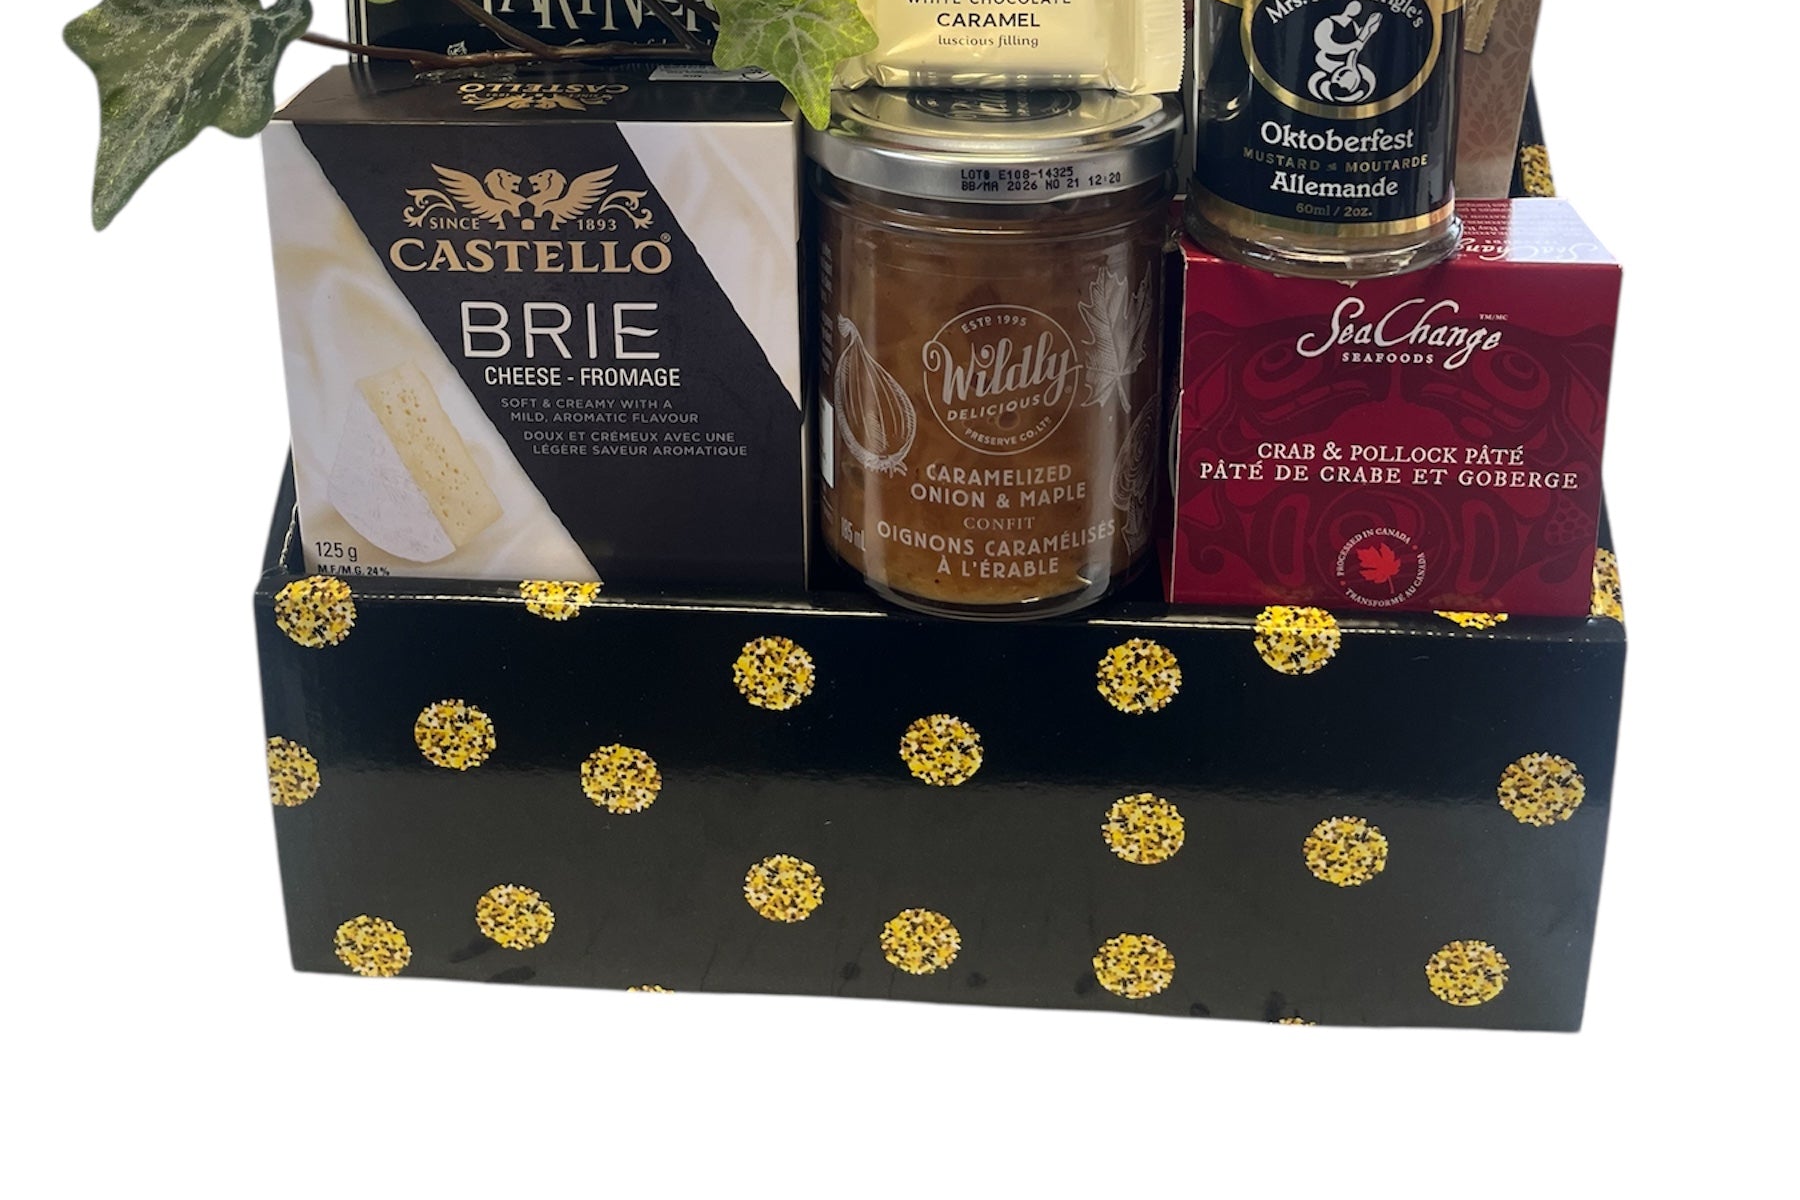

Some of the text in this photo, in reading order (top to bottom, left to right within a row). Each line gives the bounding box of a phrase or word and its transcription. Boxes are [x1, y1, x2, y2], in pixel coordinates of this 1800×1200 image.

[937, 13, 1040, 27] CARAMEL
[938, 35, 1039, 48] luscious filling
[458, 83, 629, 94] CASTELLO
[1261, 121, 1414, 152] Oktoberfest
[1243, 146, 1428, 173] MUSTARD MOUTARDE
[961, 172, 1121, 191] BB/MA 2026 NO 21 12:20
[999, 166, 1074, 180] E108-14325
[1270, 171, 1399, 197] Allemande
[1296, 203, 1331, 215] 60ml
[1344, 206, 1373, 217] 2oz.
[430, 216, 617, 231] SINCE 1893
[389, 237, 672, 274] CASTELLO
[460, 301, 660, 359] BRIE
[997, 315, 1027, 327] 1995
[1342, 352, 1434, 364] SEAFOODS
[484, 366, 561, 386] CHEESE
[581, 367, 680, 386] FROMAGE
[922, 331, 1083, 406] Wildly
[500, 398, 672, 409] SOFT & CREAMY WITH A
[947, 394, 1041, 421] DELICIOUS
[510, 412, 699, 424] MILD, AROMATIC FLAVOUR
[523, 429, 735, 442] DOUX ET CRÉMEUX AVEC UNE
[965, 428, 1017, 446] PRESERVE
[533, 442, 748, 456] LÉGÈRE SAVEUR AROMATIQUE
[1257, 441, 1524, 465] CRAB & POLLOCK PÂTÉ
[926, 464, 1071, 487] CARAMELIZED
[1200, 459, 1578, 489] PÂTÉ DE CRABE ET GOBERGE
[910, 482, 1086, 508] ONION & MAPLE
[963, 516, 1036, 530] CONFIT
[877, 519, 1115, 557] OIGNONS CARAMÉLISÉS
[315, 542, 357, 562] 125 g
[1336, 527, 1411, 577] PROCESSED IN CANADA
[937, 555, 1059, 578] À L'ÉRABLE
[1405, 585, 1416, 598] AU
[1413, 552, 1427, 587] CANADA
